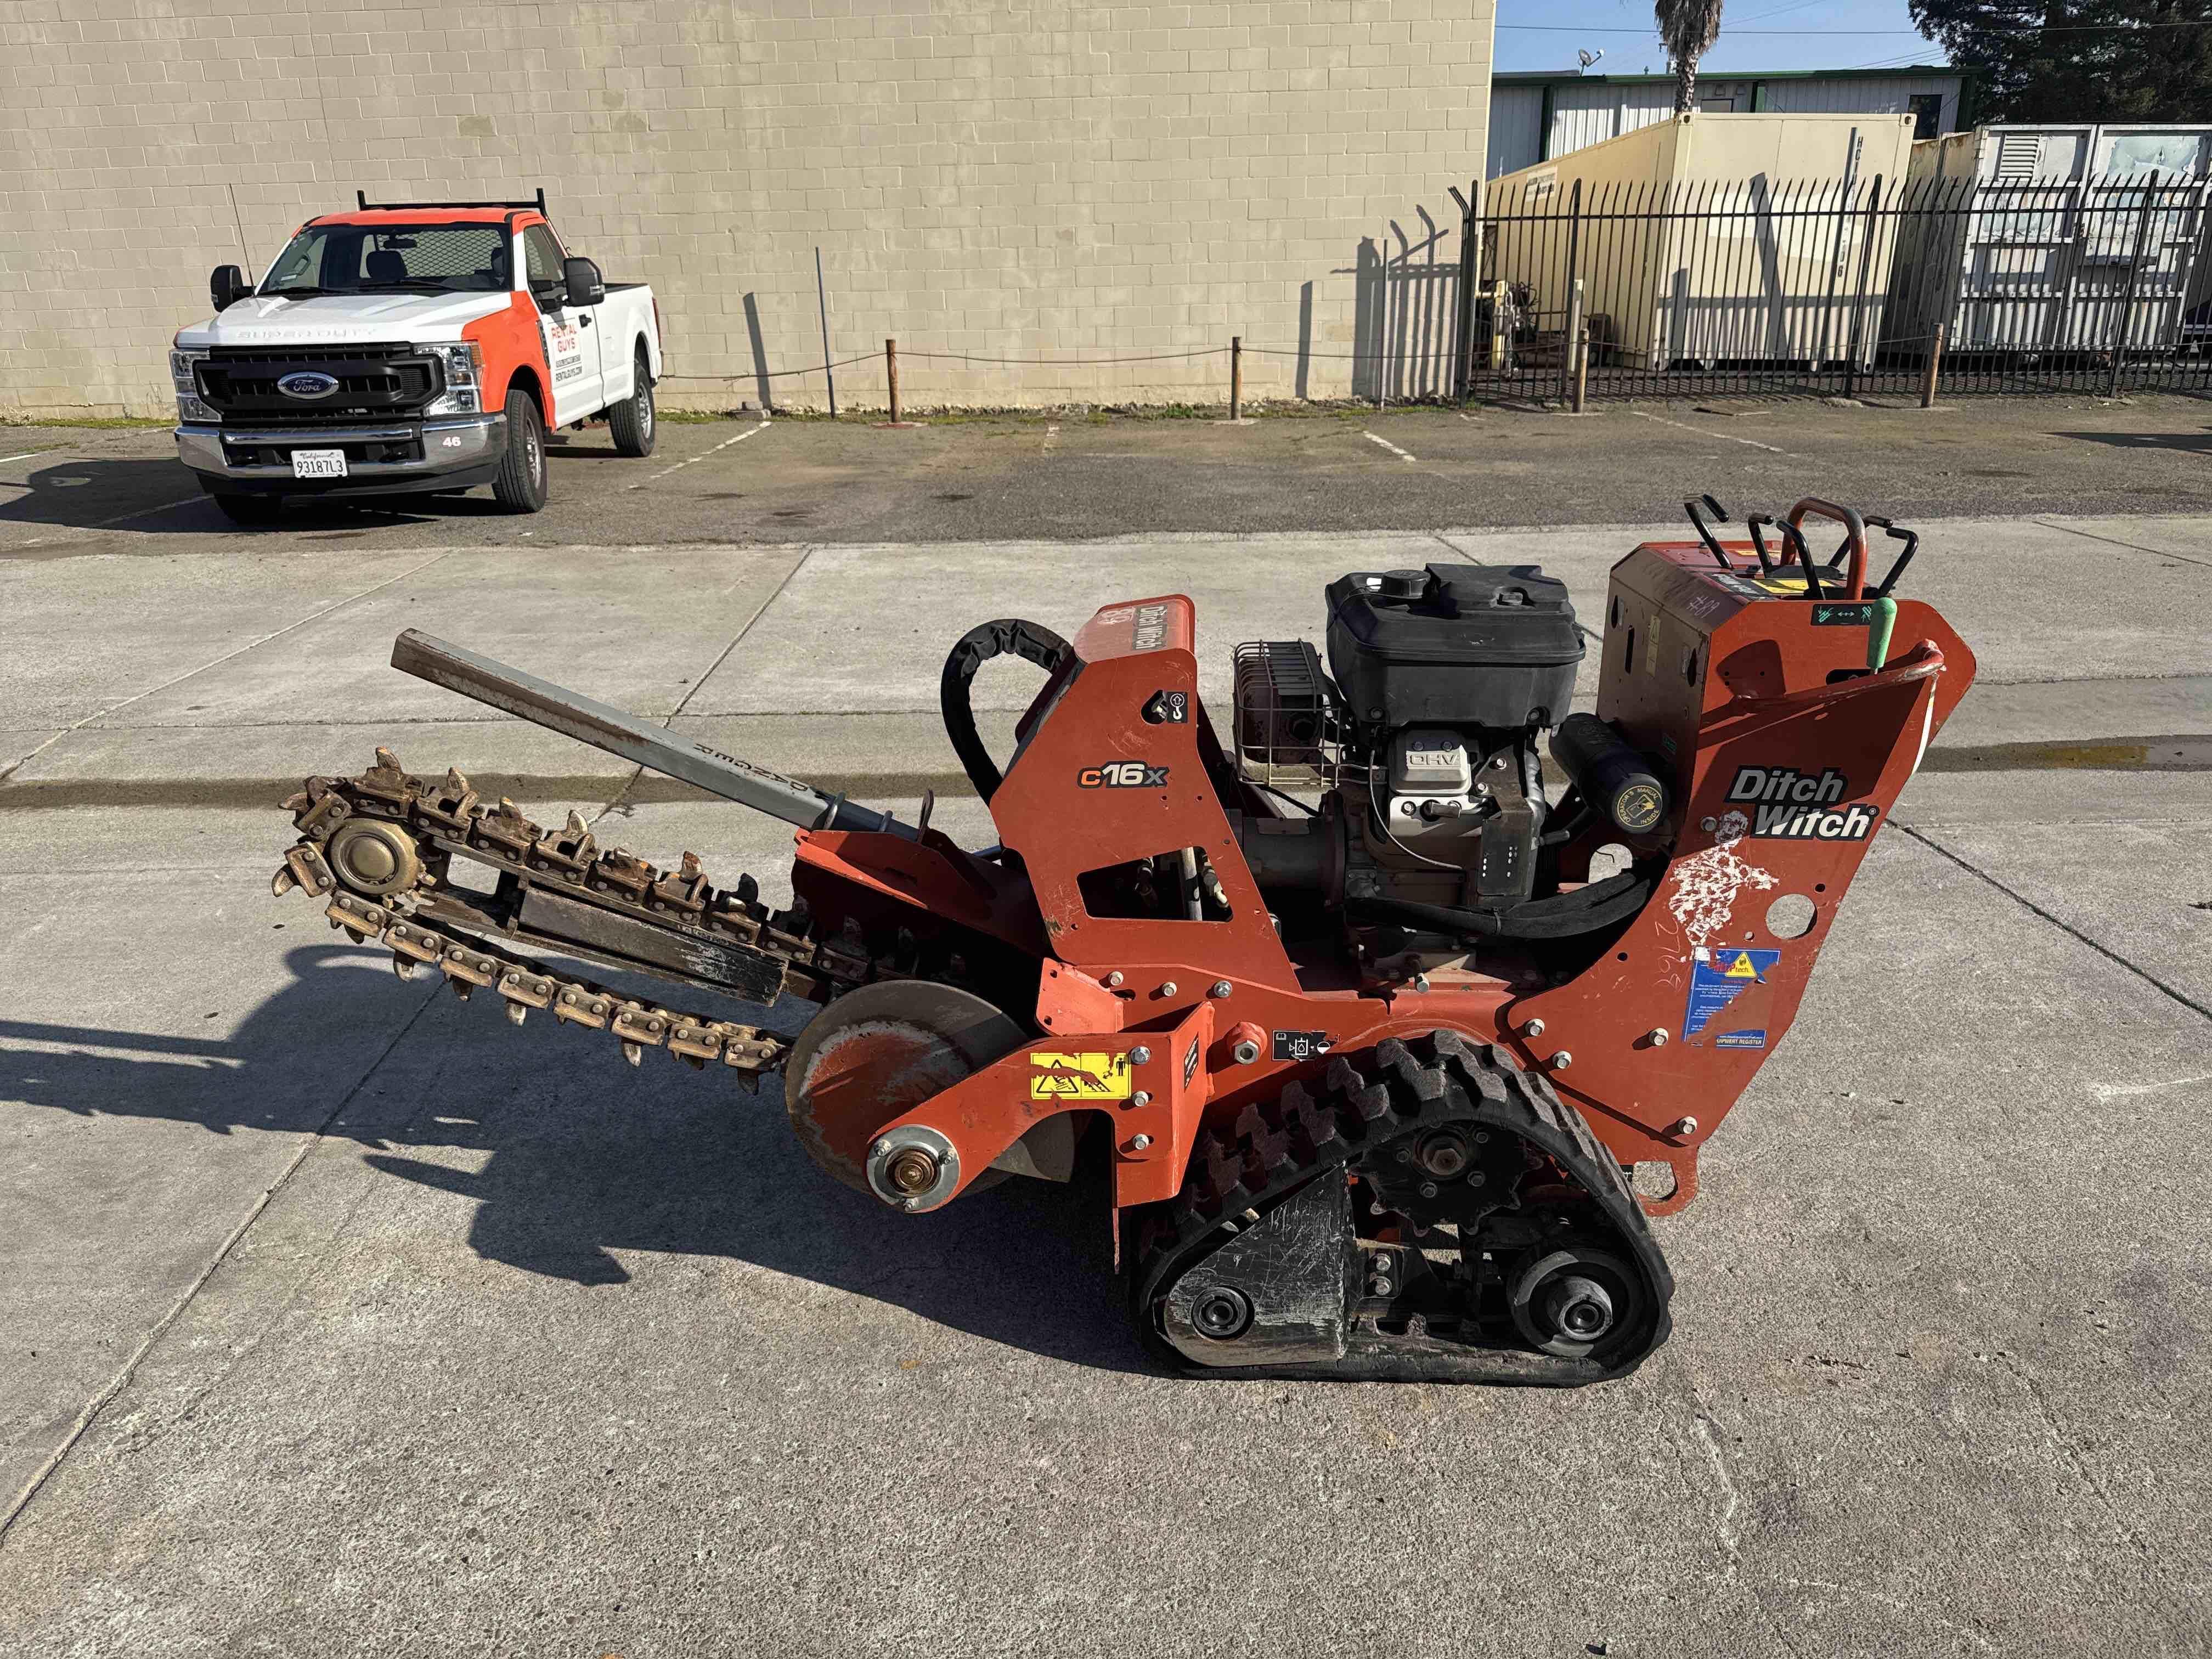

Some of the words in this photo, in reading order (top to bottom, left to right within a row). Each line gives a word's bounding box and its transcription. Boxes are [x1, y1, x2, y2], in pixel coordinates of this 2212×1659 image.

[551, 324, 577, 338] RENTAL
[557, 338, 575, 353] GUYS
[292, 378, 322, 392] Ford
[443, 437, 461, 447] 46
[297, 460, 343, 473] 93187L3
[1138, 606, 1164, 626] Ditch
[1136, 625, 1163, 650] Witch
[693, 743, 808, 792] DANGER
[1410, 754, 1457, 765] OHV
[1730, 769, 1843, 802] Ditch
[1620, 791, 1634, 822] OPERATOR'S
[1637, 787, 1660, 800] MANUAL
[1640, 809, 1660, 825] INSIDE
[1756, 805, 1870, 837] Witch
